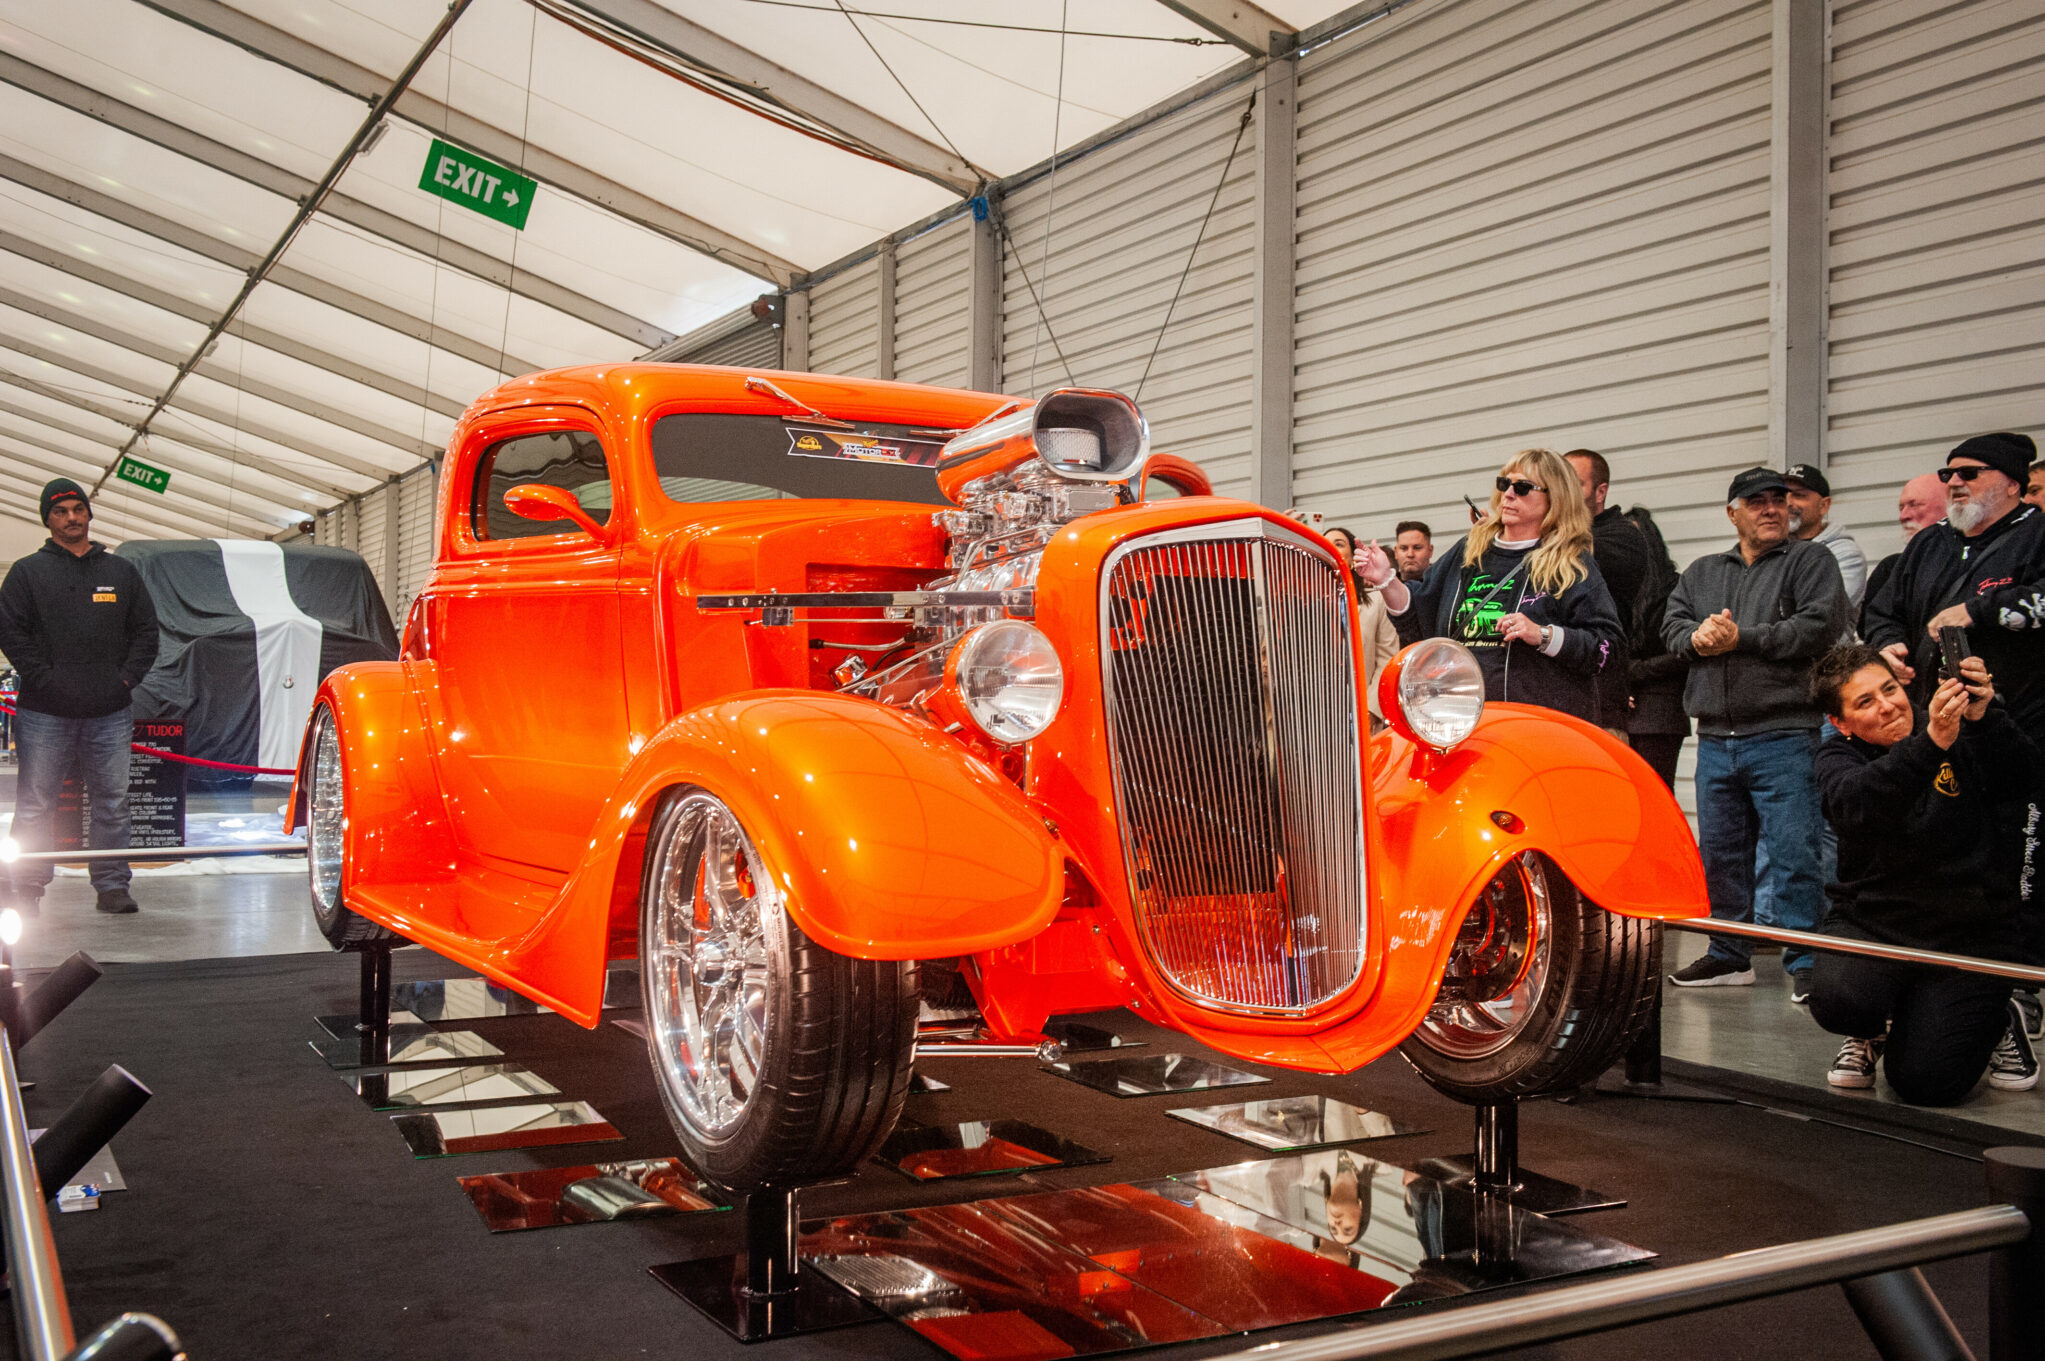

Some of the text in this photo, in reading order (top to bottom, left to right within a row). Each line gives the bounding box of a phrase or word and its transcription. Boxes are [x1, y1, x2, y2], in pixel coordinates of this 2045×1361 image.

[434, 155, 502, 203] EXIT
[123, 463, 155, 483] EXIT
[147, 725, 183, 736] TUDOR
[2022, 803, 2041, 835] Albury
[2024, 837, 2040, 864] Street
